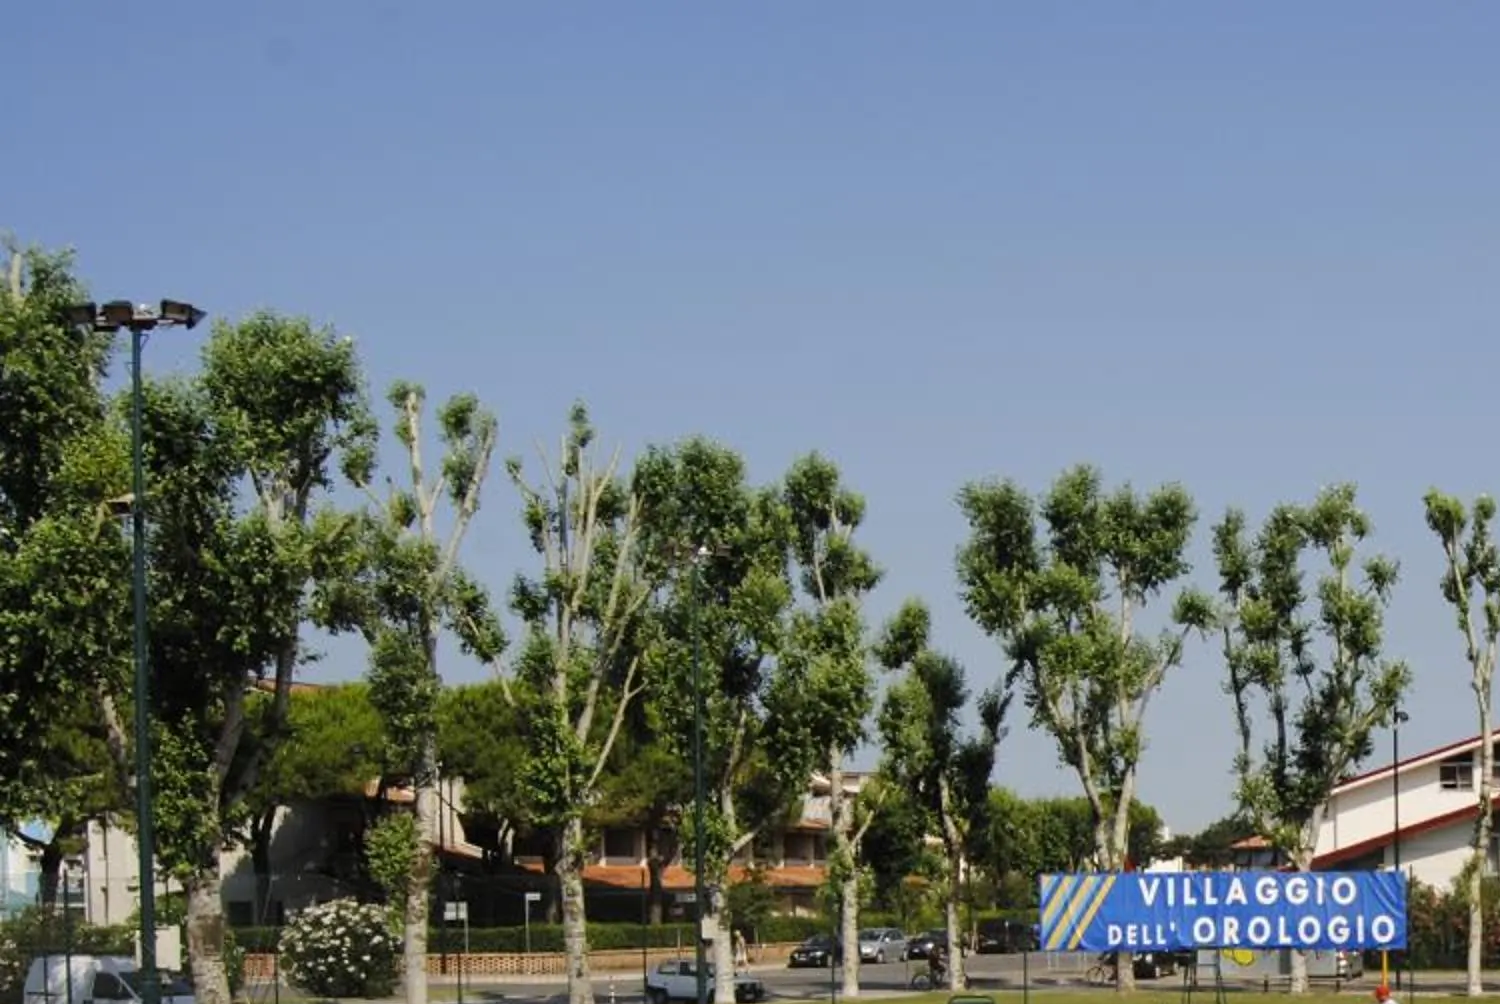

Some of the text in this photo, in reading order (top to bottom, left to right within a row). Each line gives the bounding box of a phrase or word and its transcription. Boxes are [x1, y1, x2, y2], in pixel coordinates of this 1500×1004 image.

[1138, 876, 1357, 907] VILLAGGIO
[1107, 914, 1396, 946] DELL' OROLOGIO
